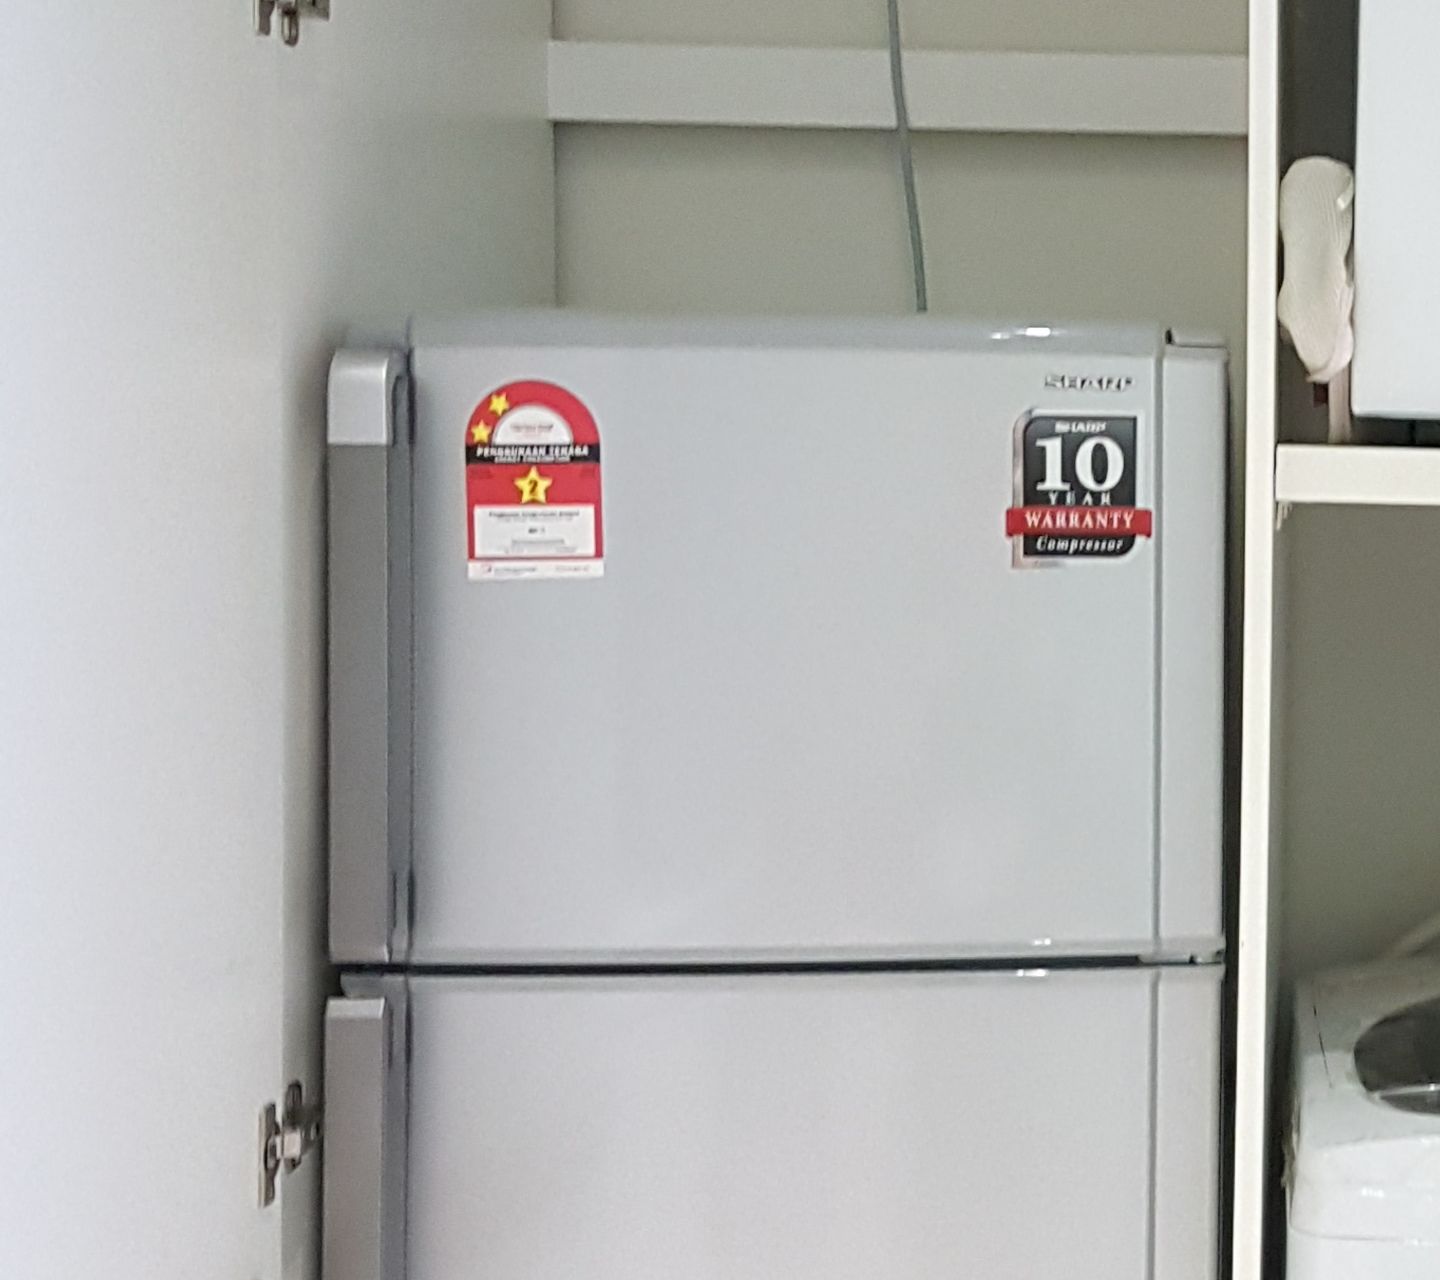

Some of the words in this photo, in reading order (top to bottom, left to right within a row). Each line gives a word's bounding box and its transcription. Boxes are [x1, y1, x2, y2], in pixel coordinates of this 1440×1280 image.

[1044, 374, 1132, 391] SHARP
[1035, 435, 1124, 492] 10
[528, 479, 539, 494] 2
[1048, 491, 1112, 506] YEAR
[1025, 510, 1135, 529] WARRANTY
[1036, 535, 1124, 554] Compressor
